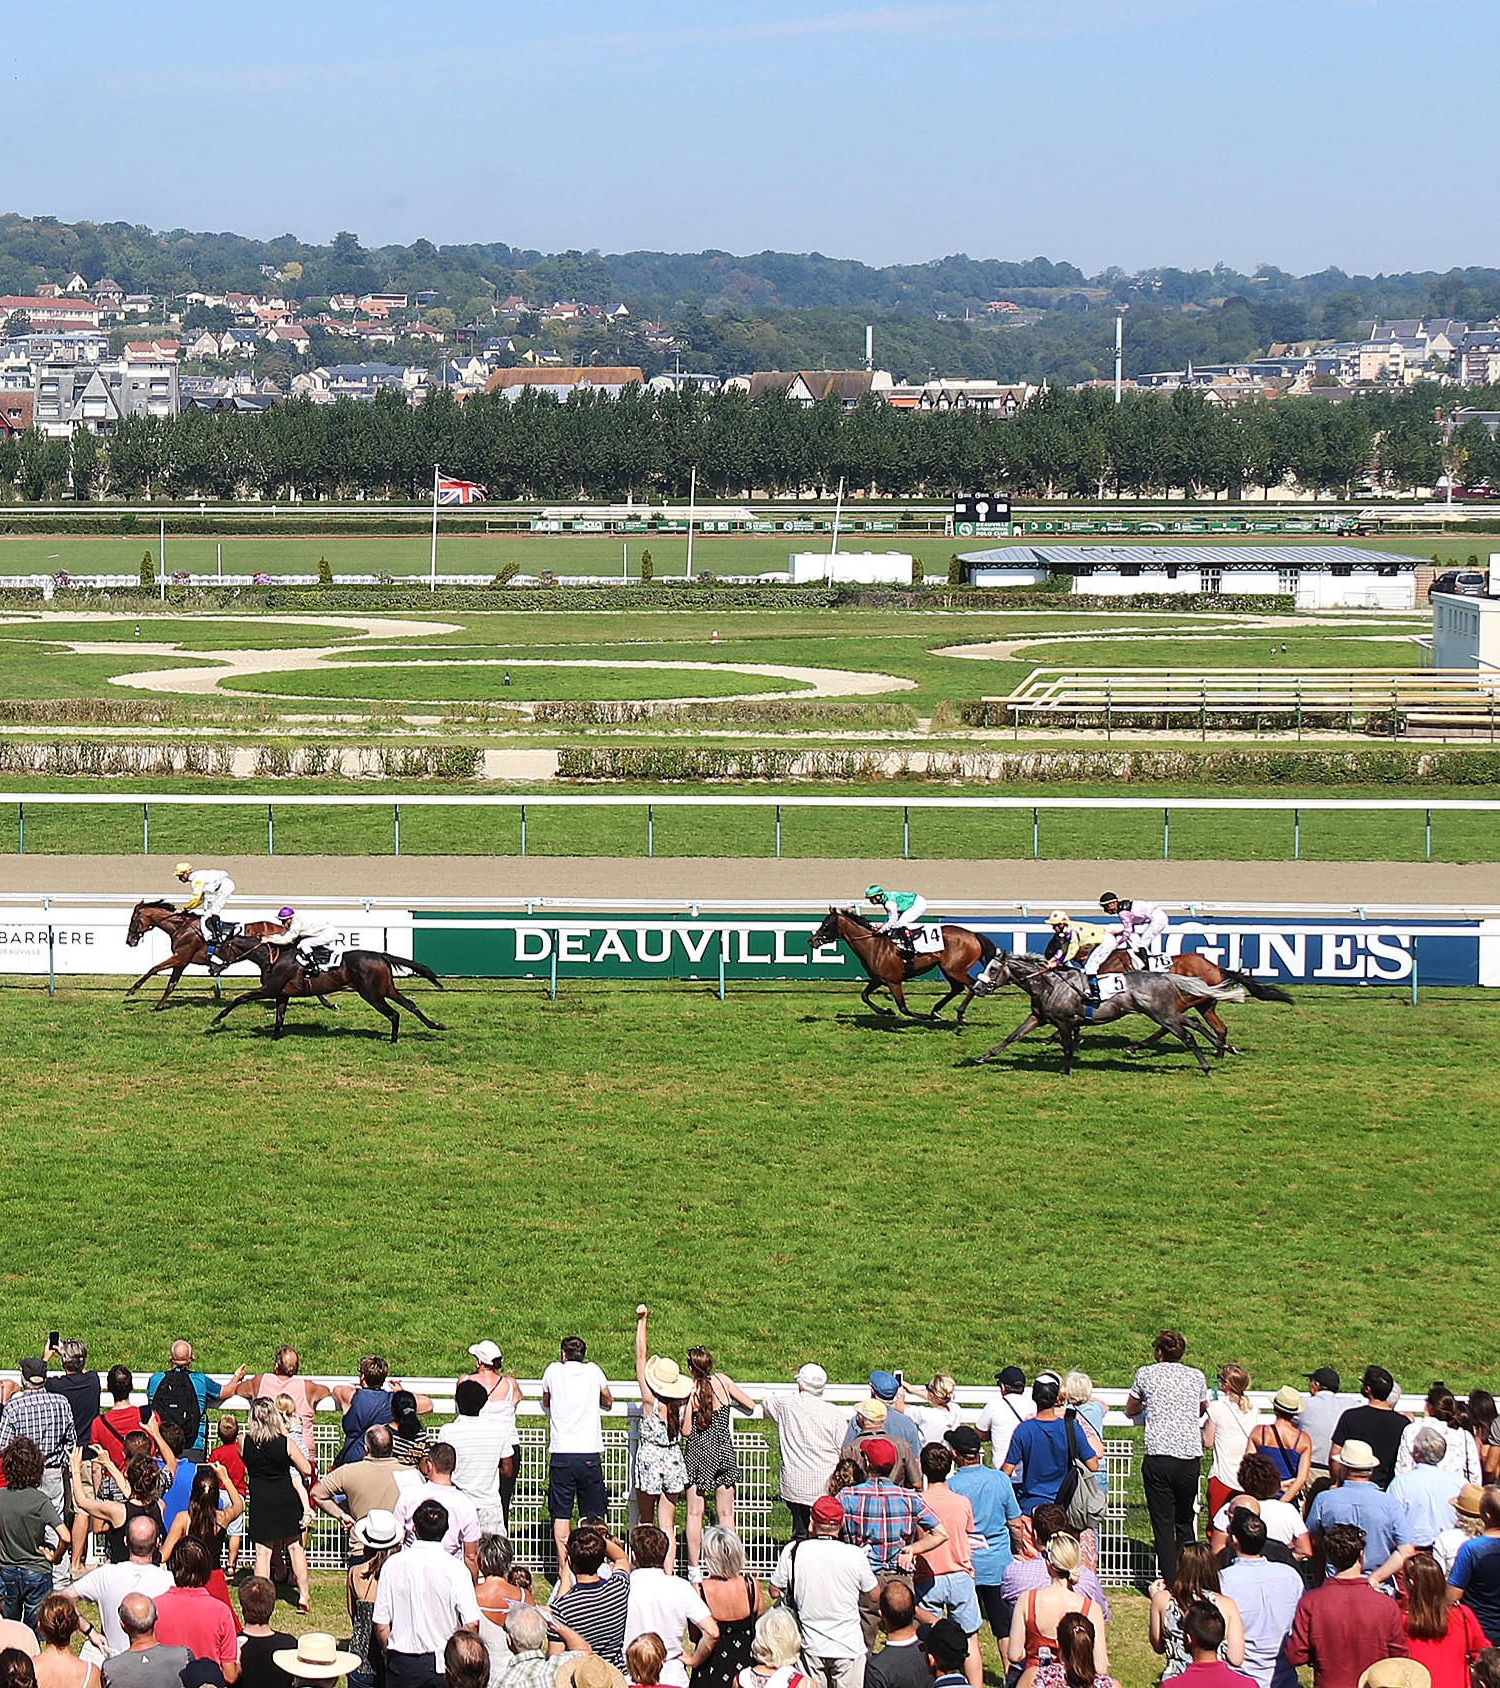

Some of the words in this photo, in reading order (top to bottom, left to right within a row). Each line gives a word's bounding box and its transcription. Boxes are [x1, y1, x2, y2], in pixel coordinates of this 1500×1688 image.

[514, 928, 845, 965] DEAUVILLE
[921, 928, 940, 944] 14
[1013, 924, 1413, 980] GINES
[1114, 975, 1124, 991] 5
